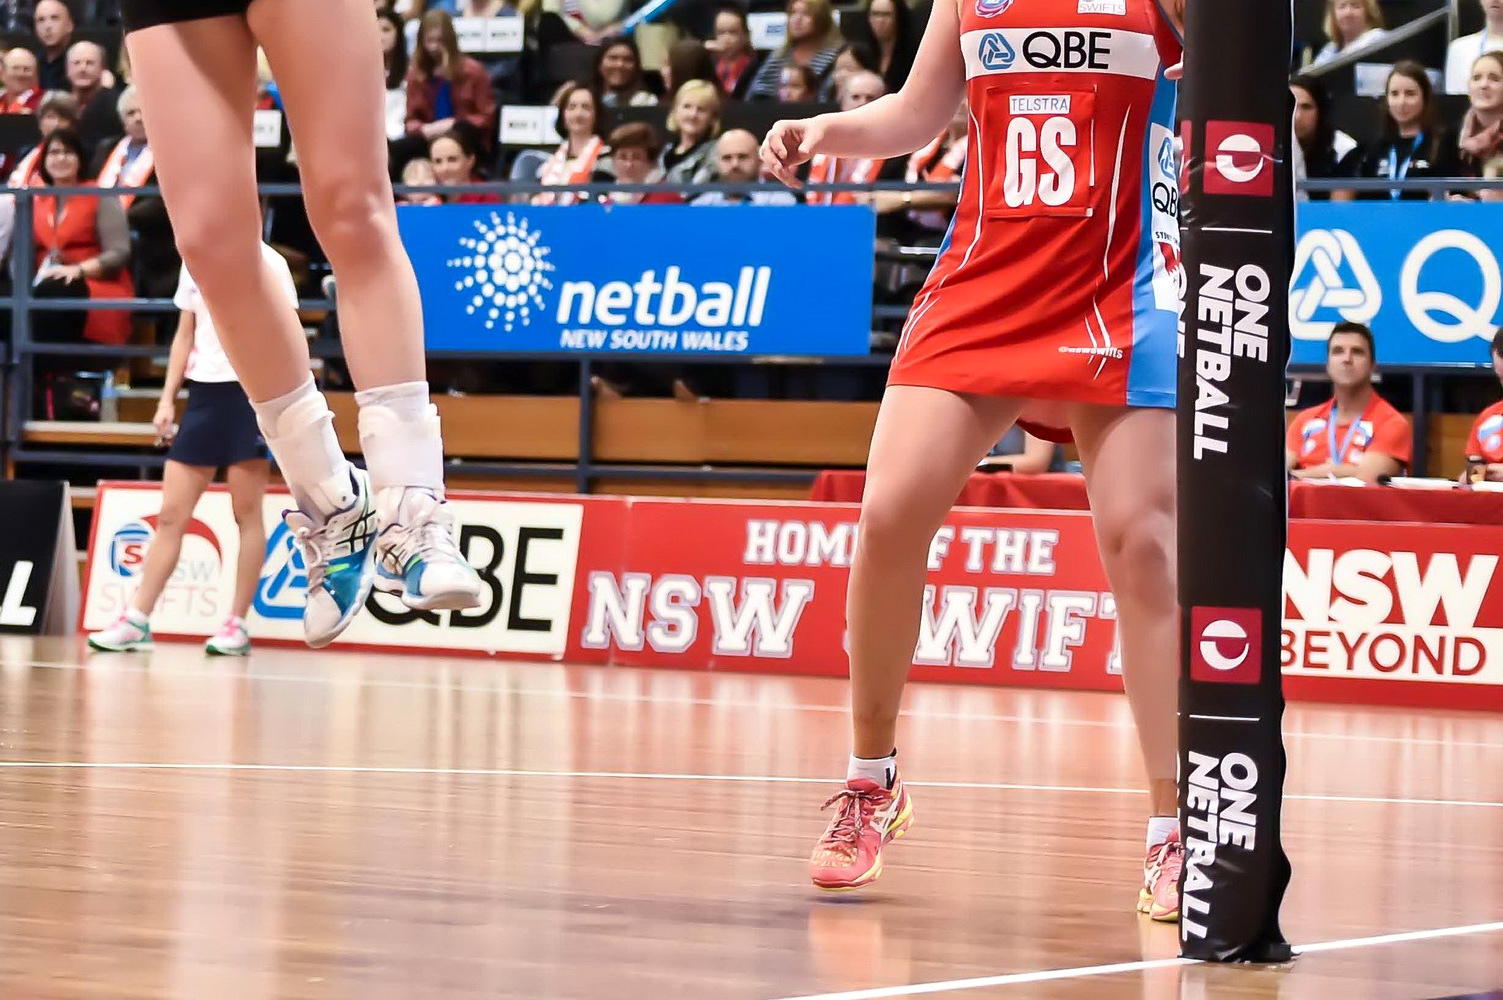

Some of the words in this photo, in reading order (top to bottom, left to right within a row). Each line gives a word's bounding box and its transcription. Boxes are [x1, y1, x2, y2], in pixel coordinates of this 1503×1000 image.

[1079, 2, 1126, 14] SWIFTS
[1023, 31, 1112, 70] QBE
[1011, 98, 1068, 111] TELSTRA
[1003, 116, 1077, 208] GS
[1152, 182, 1178, 217] QB
[557, 265, 772, 327] netball
[1235, 263, 1271, 362] ONE
[561, 330, 607, 350] NEW
[610, 330, 679, 351] SOUTH
[682, 331, 749, 351] WALES
[1193, 263, 1235, 460] NETBALL
[172, 557, 215, 583] SW
[744, 519, 859, 567] HOM
[927, 525, 955, 571] F
[961, 526, 1059, 575] THE
[365, 524, 565, 633] BE
[1282, 547, 1499, 629] NSW
[581, 571, 815, 659] NSW
[1281, 629, 1487, 677] BEYOND
[1220, 752, 1259, 851] ONE
[1182, 751, 1220, 942] NETBALL
